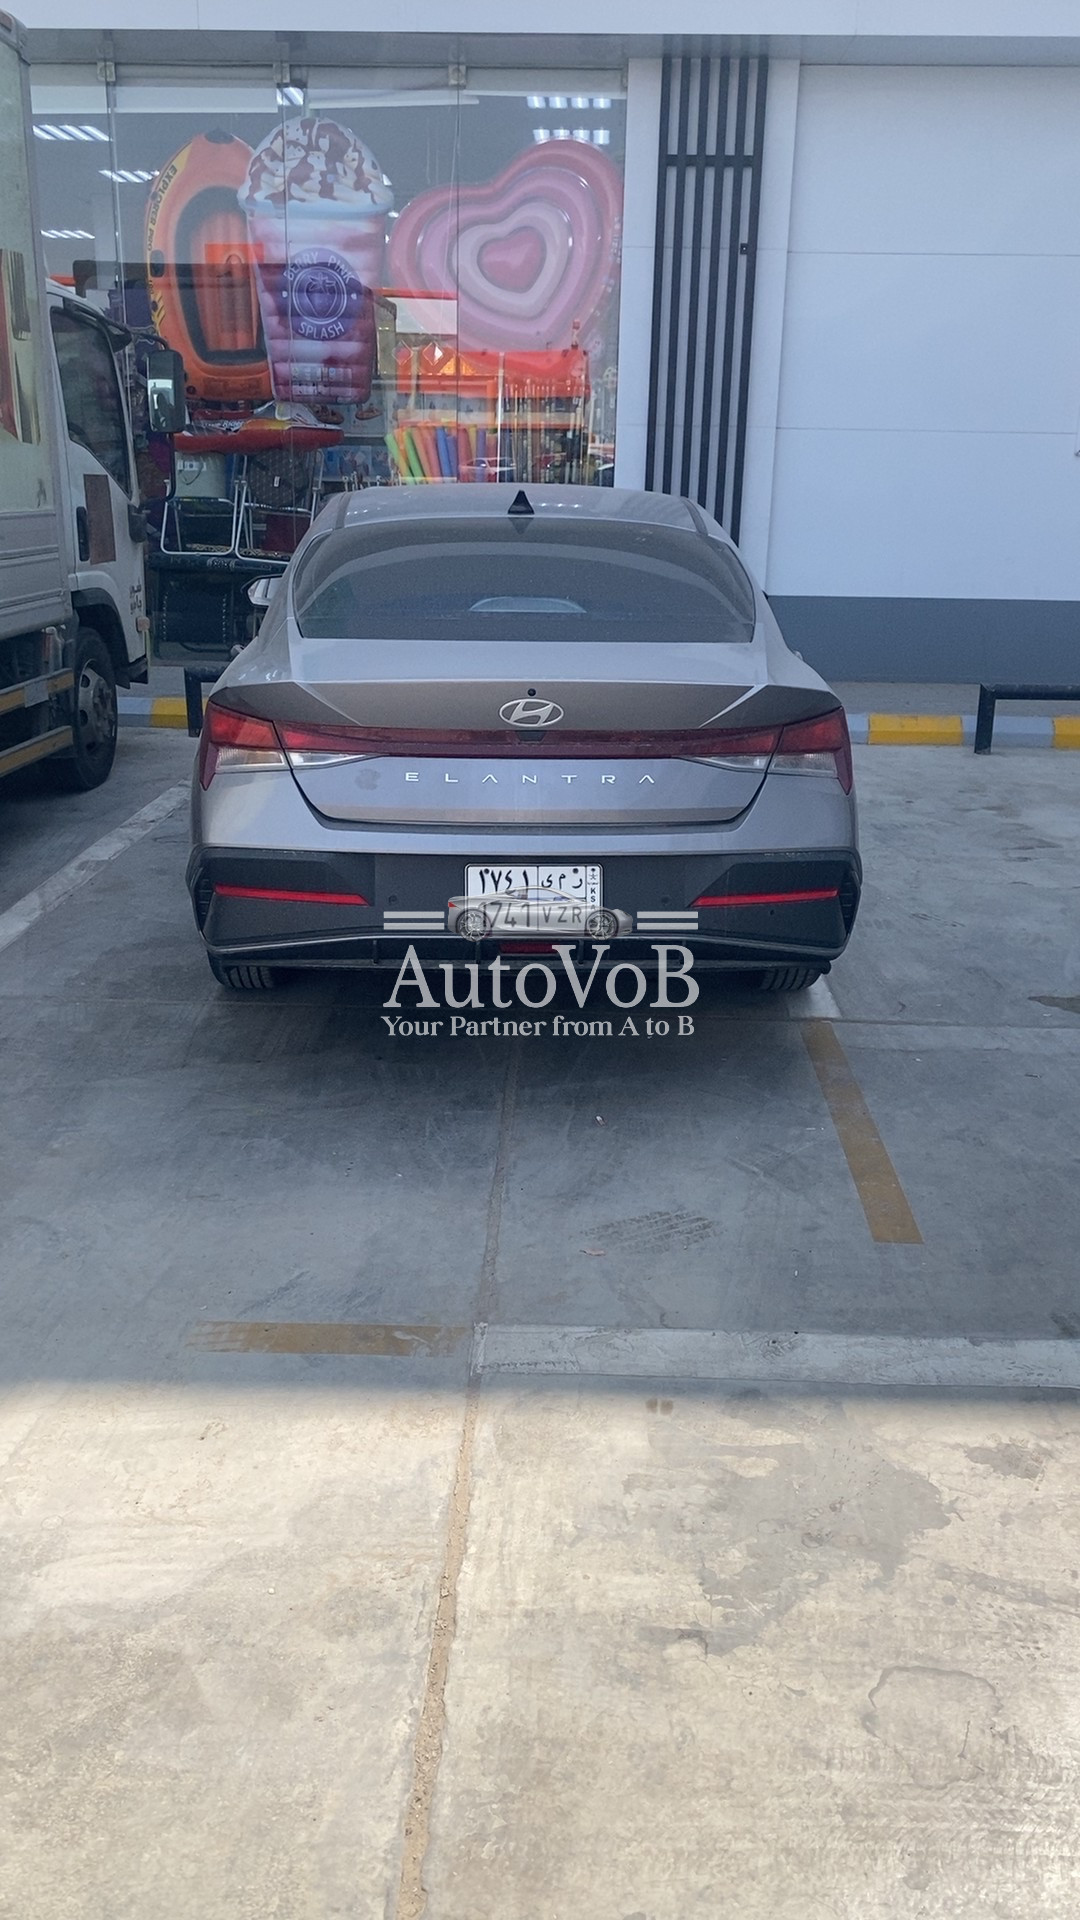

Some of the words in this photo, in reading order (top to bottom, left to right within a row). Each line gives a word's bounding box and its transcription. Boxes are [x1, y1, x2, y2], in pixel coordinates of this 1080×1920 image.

[283, 251, 319, 282] BERRY
[327, 255, 355, 284] PINK
[298, 321, 345, 339] SPLASH
[405, 772, 655, 784] ELANTRA
